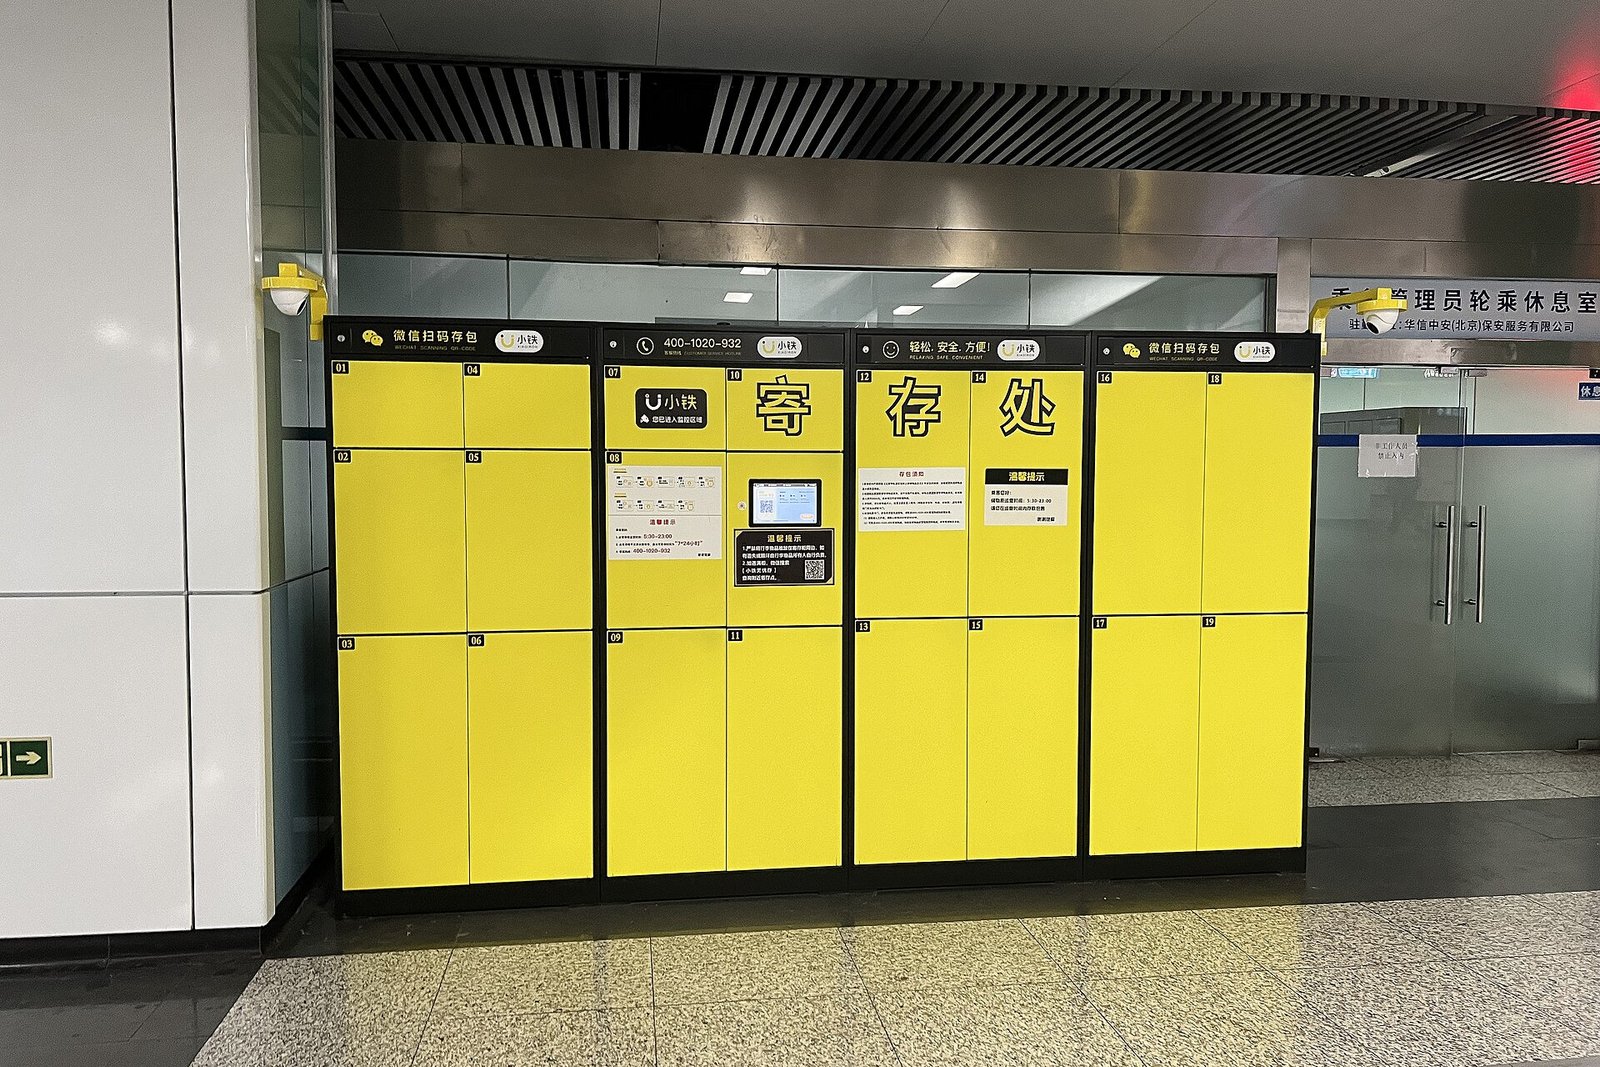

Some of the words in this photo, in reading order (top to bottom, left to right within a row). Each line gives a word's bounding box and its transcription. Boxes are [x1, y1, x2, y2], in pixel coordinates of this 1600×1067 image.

[1331, 287, 1598, 314] 理员轮乘休息室
[1349, 318, 1575, 332] 驻:华信中安(北京)保安服务有限公司
[393, 328, 478, 343] 微信扫码存包
[517, 334, 538, 345] 小铁
[663, 337, 742, 349] 400-1020-932
[777, 340, 797, 350] 小铁
[1016, 343, 1035, 353] 小铁
[1148, 342, 1220, 354] 微信扫码存包
[1253, 345, 1270, 355] 小铁
[335, 363, 347, 372] 01
[467, 365, 478, 374] 04
[608, 368, 619, 376] 07
[730, 371, 740, 379] 10
[860, 372, 870, 381] 12
[975, 373, 985, 382] 14
[1100, 374, 1110, 382] 16
[1210, 374, 1220, 383] 18
[664, 394, 697, 410] 小铁
[1375, 442, 1408, 450] 非工作人员
[337, 452, 348, 461] 02
[468, 453, 479, 461] 05
[609, 454, 620, 462] 08
[1009, 471, 1045, 482] 温馨提示
[767, 534, 802, 543] 温馨提示
[971, 621, 981, 629] 15
[1095, 619, 1105, 627] 17
[1205, 617, 1214, 626] 19
[859, 623, 869, 631] 13
[471, 636, 482, 644] 06
[610, 633, 621, 642] 09
[730, 631, 740, 640] 11
[341, 640, 352, 648] 03
